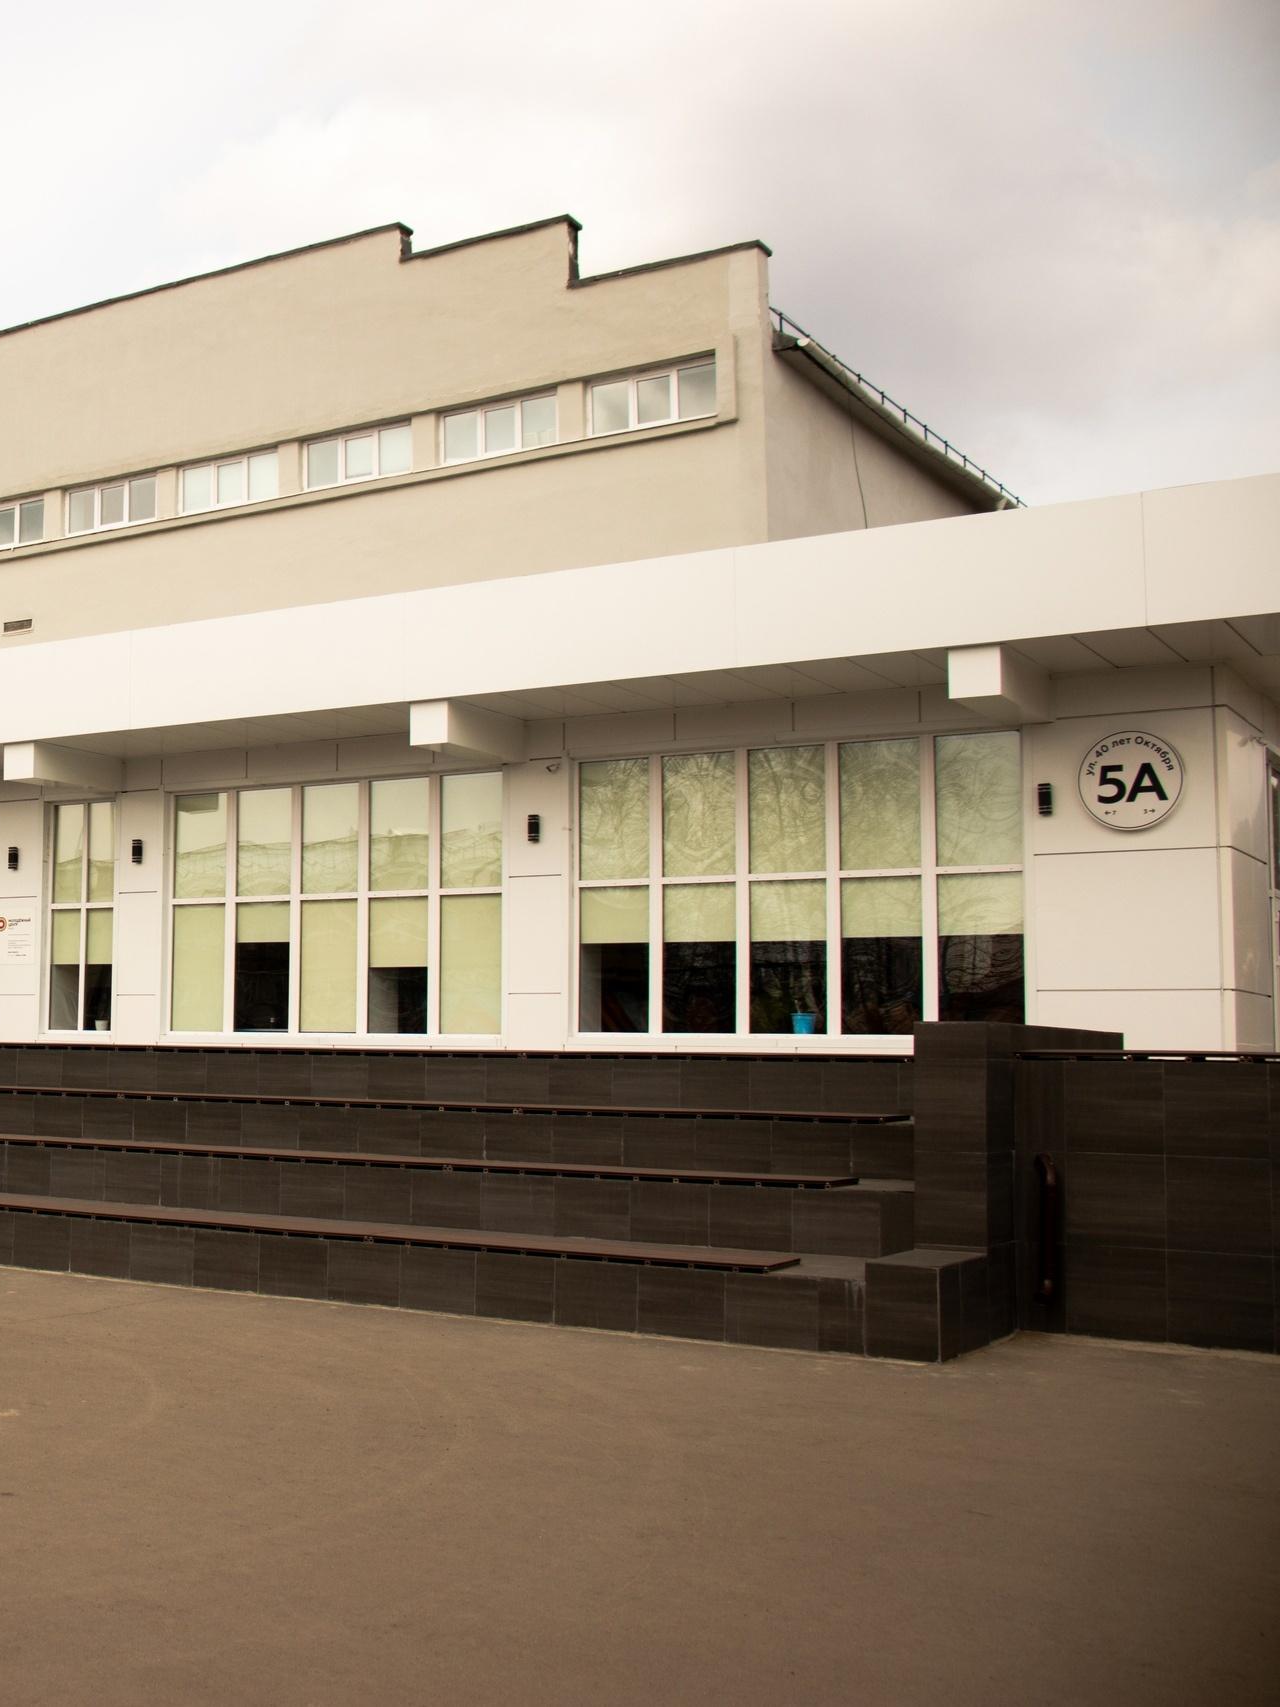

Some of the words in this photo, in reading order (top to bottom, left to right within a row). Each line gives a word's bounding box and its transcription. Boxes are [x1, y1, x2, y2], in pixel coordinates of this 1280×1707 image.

[1086, 761, 1098, 776] ул.
[1095, 744, 1109, 758] 40
[1111, 737, 1132, 748] лет
[1134, 736, 1175, 771] Октября
[1097, 762, 1169, 804] 5А
